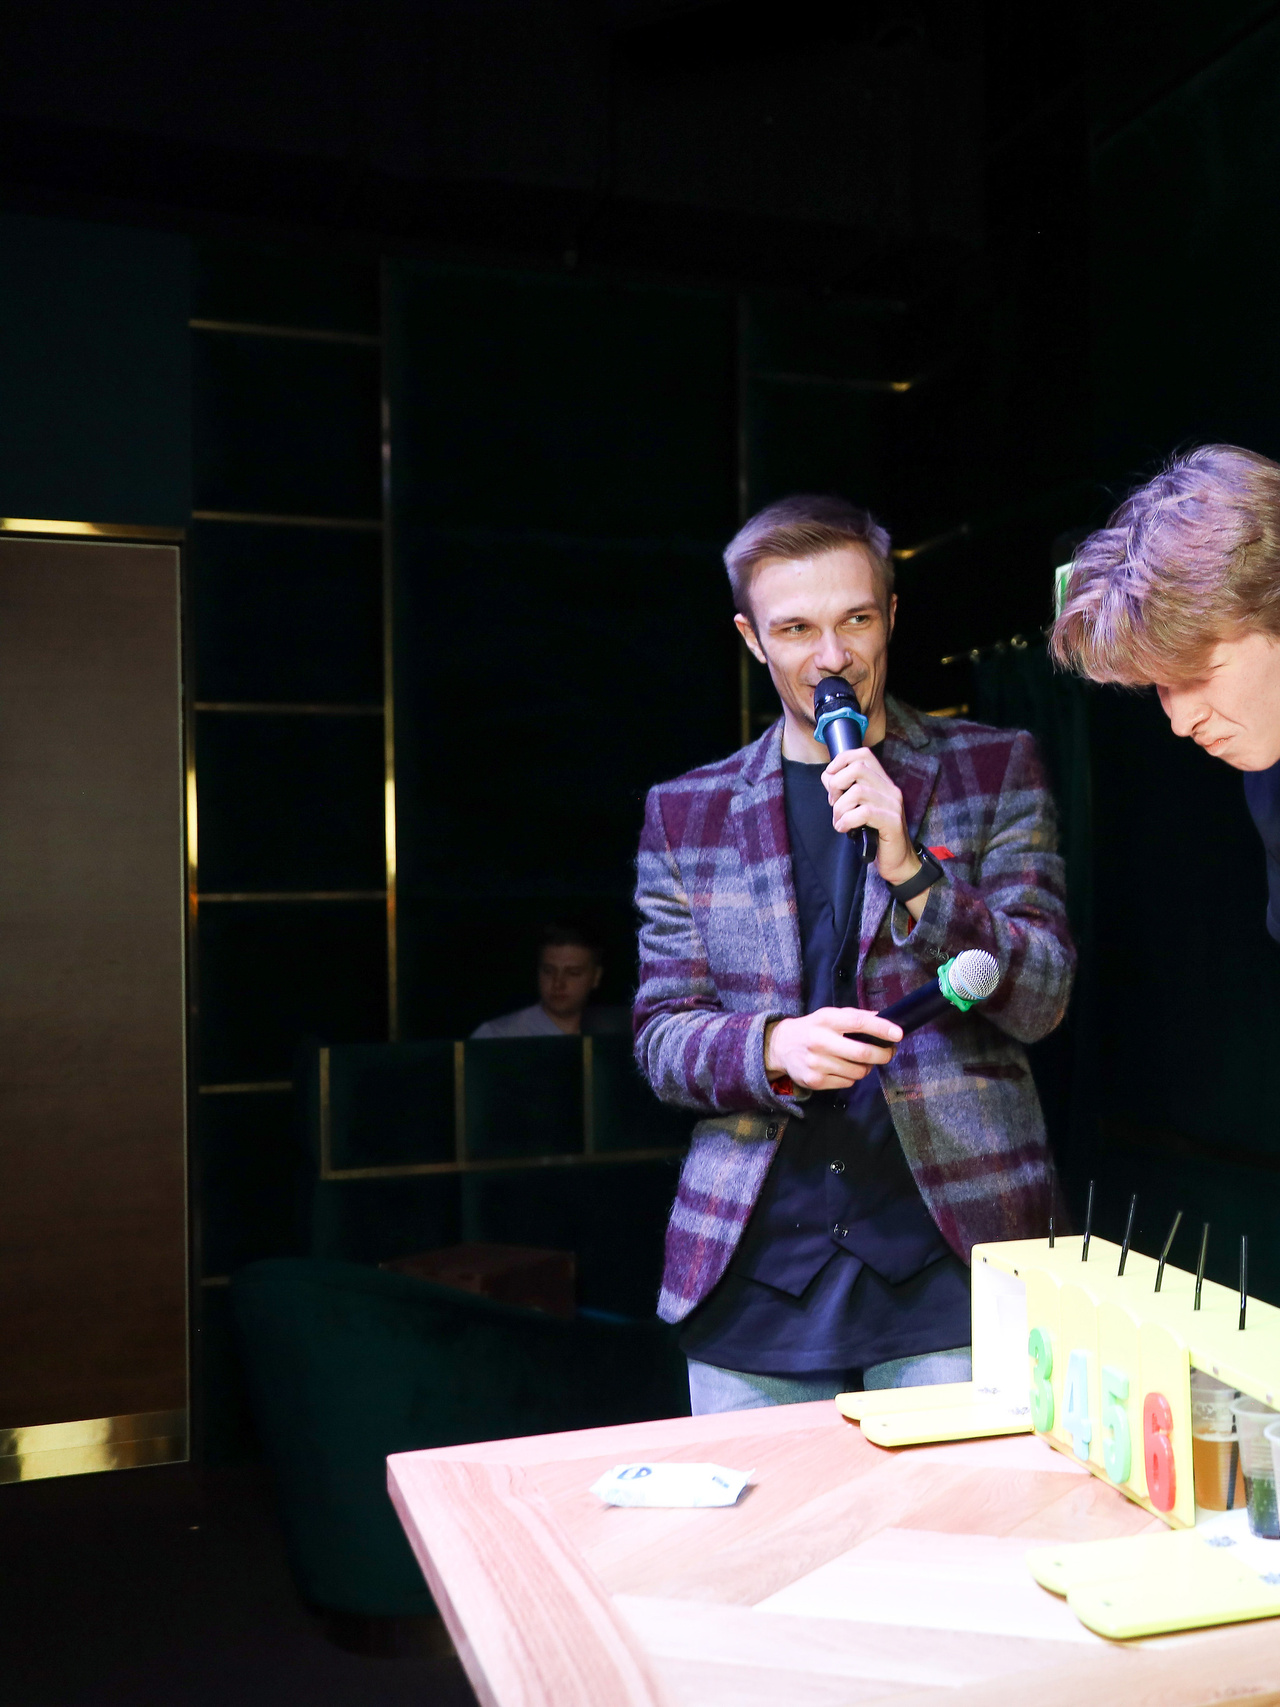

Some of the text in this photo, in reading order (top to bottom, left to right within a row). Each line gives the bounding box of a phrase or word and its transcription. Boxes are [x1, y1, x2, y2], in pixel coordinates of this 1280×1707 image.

[1028, 1327, 1176, 1513] 3 4 5 6
